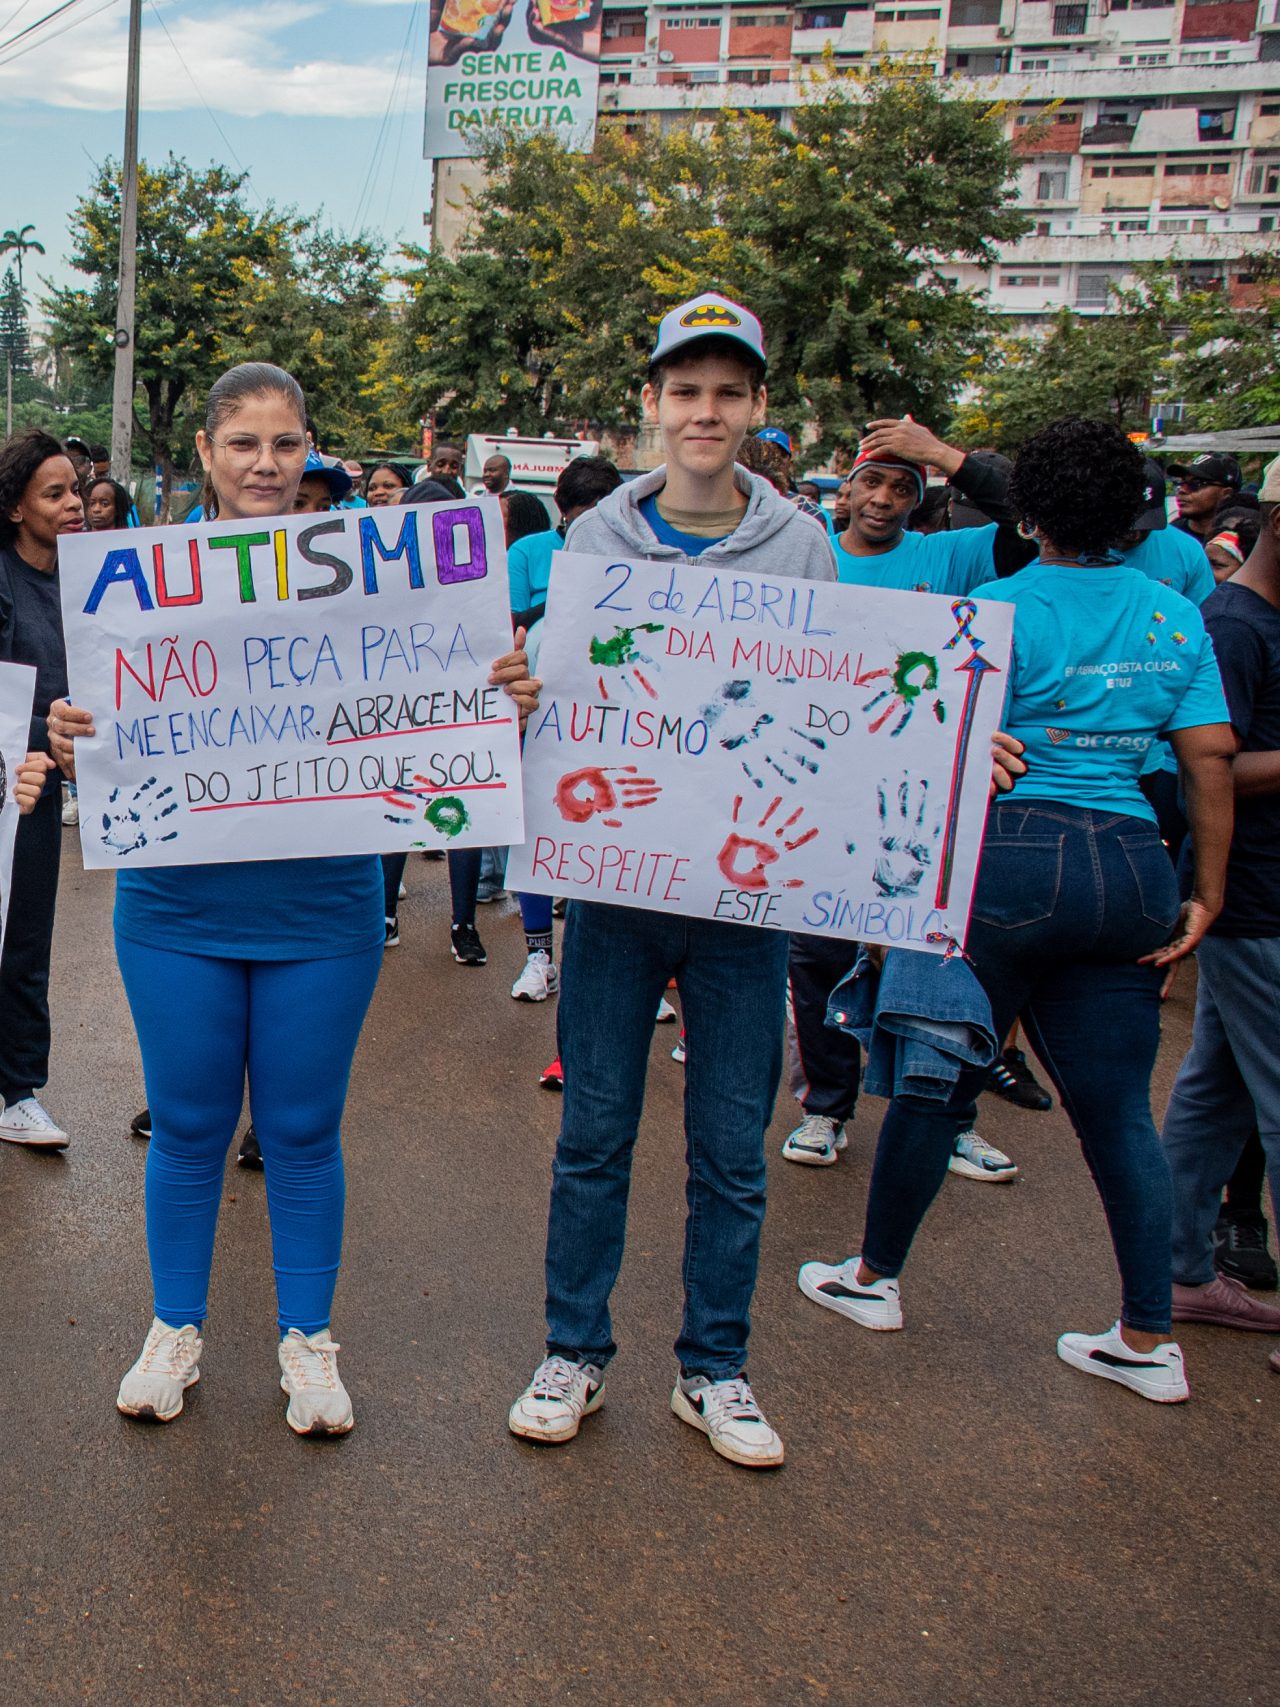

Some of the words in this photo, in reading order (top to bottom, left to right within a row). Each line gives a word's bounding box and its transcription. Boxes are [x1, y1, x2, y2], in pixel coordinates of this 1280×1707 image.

[444, 78, 582, 103] FRESCURA
[461, 52, 542, 76] SENTE
[549, 51, 567, 72] A
[448, 108, 482, 130] DA
[82, 506, 488, 615] AUTISMO
[594, 563, 633, 613] 2
[648, 568, 687, 615] de
[691, 575, 837, 636] ABRIL
[115, 635, 218, 711] NÃO
[243, 634, 343, 694] PEÇA
[361, 623, 478, 681] PARA
[665, 626, 717, 664] DIA
[731, 637, 872, 688] MUNDIAL
[1118, 662, 1143, 673] ESTA
[168, 704, 320, 757] ENCAIXAR.
[326, 687, 500, 742] ABRACE-ME
[534, 701, 708, 755] AUTISMO
[805, 703, 851, 736] DO
[186, 770, 230, 804] DO
[246, 756, 348, 802] JEITO
[359, 755, 417, 790] QUE
[429, 751, 501, 788] SOU.
[531, 836, 691, 901] RESPEITE
[713, 889, 783, 928] ESTE
[802, 890, 945, 943] SÍMBOLO
